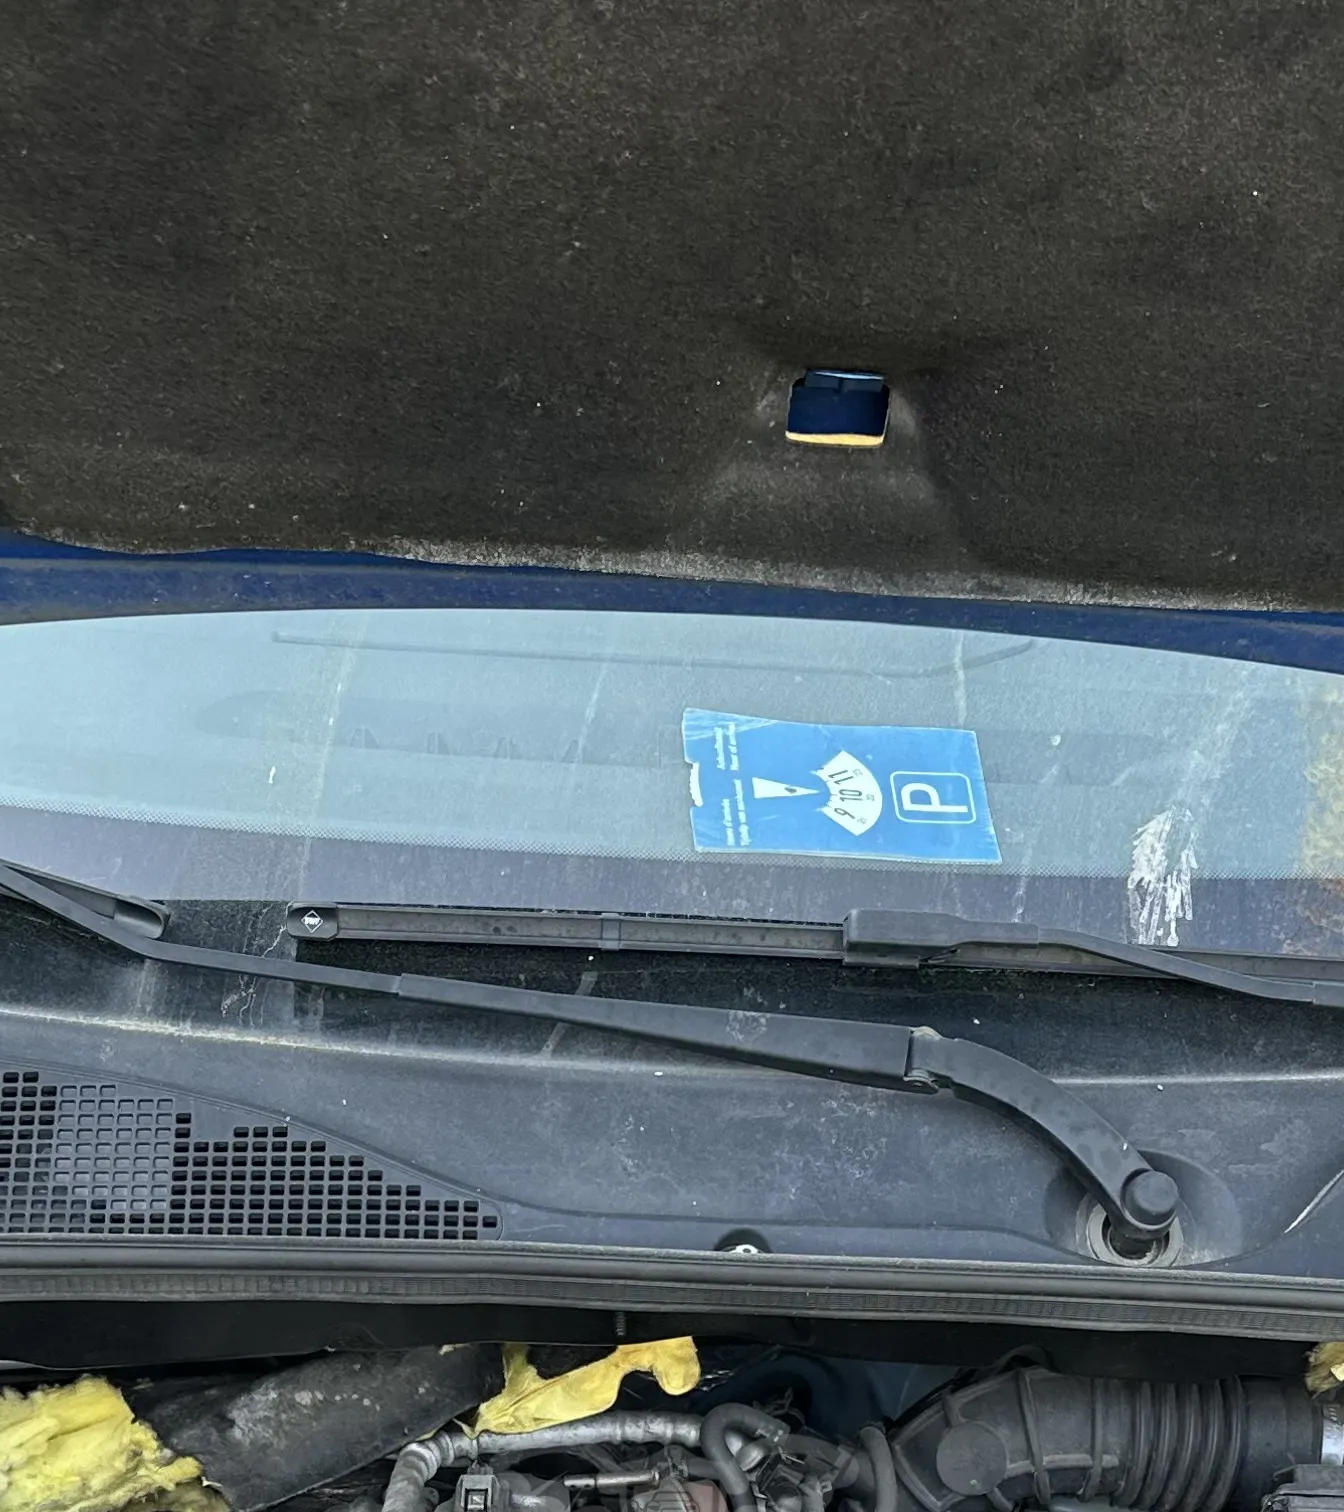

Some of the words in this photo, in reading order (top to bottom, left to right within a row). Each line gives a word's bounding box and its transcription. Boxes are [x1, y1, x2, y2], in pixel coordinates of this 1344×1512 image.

[828, 769, 854, 785] 11
[838, 788, 863, 802] 10
[900, 782, 969, 813] P
[833, 807, 855, 820] 9
